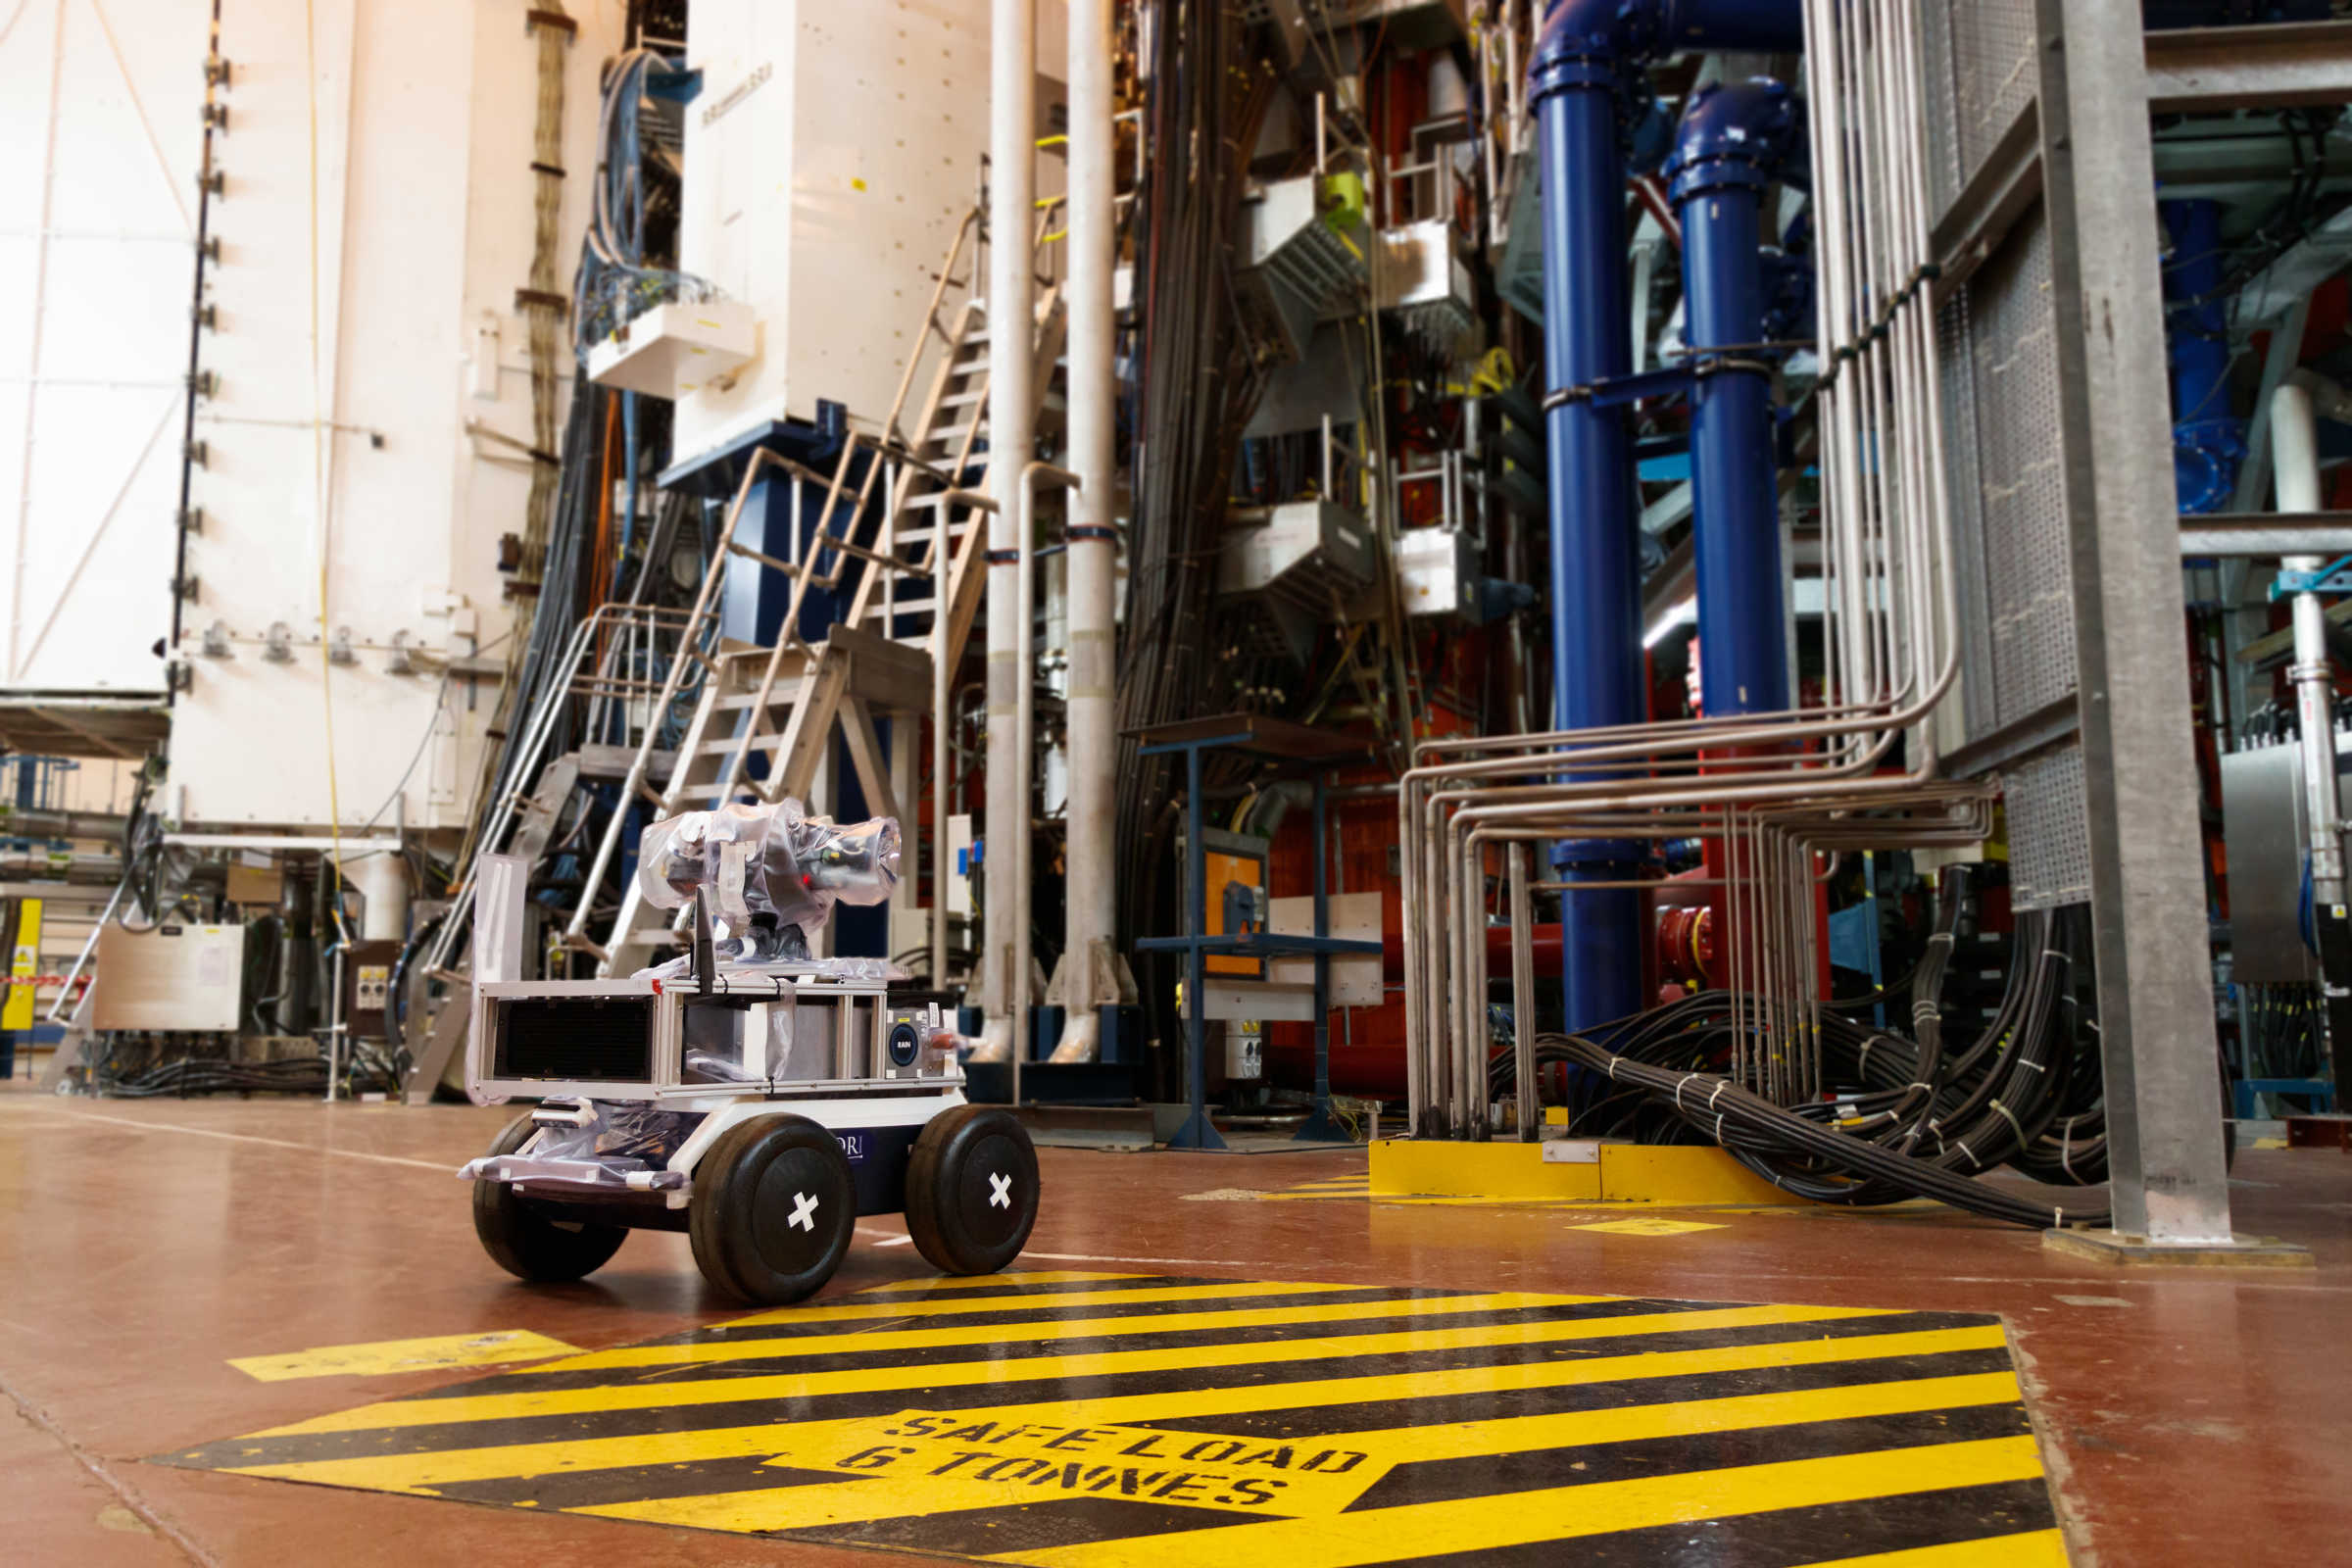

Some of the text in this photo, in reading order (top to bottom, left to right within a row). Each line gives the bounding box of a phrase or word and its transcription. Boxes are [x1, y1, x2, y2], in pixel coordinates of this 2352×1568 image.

[884, 1417, 1368, 1473] SAFE LOAD
[836, 1446, 1288, 1505] 6 TONNES
